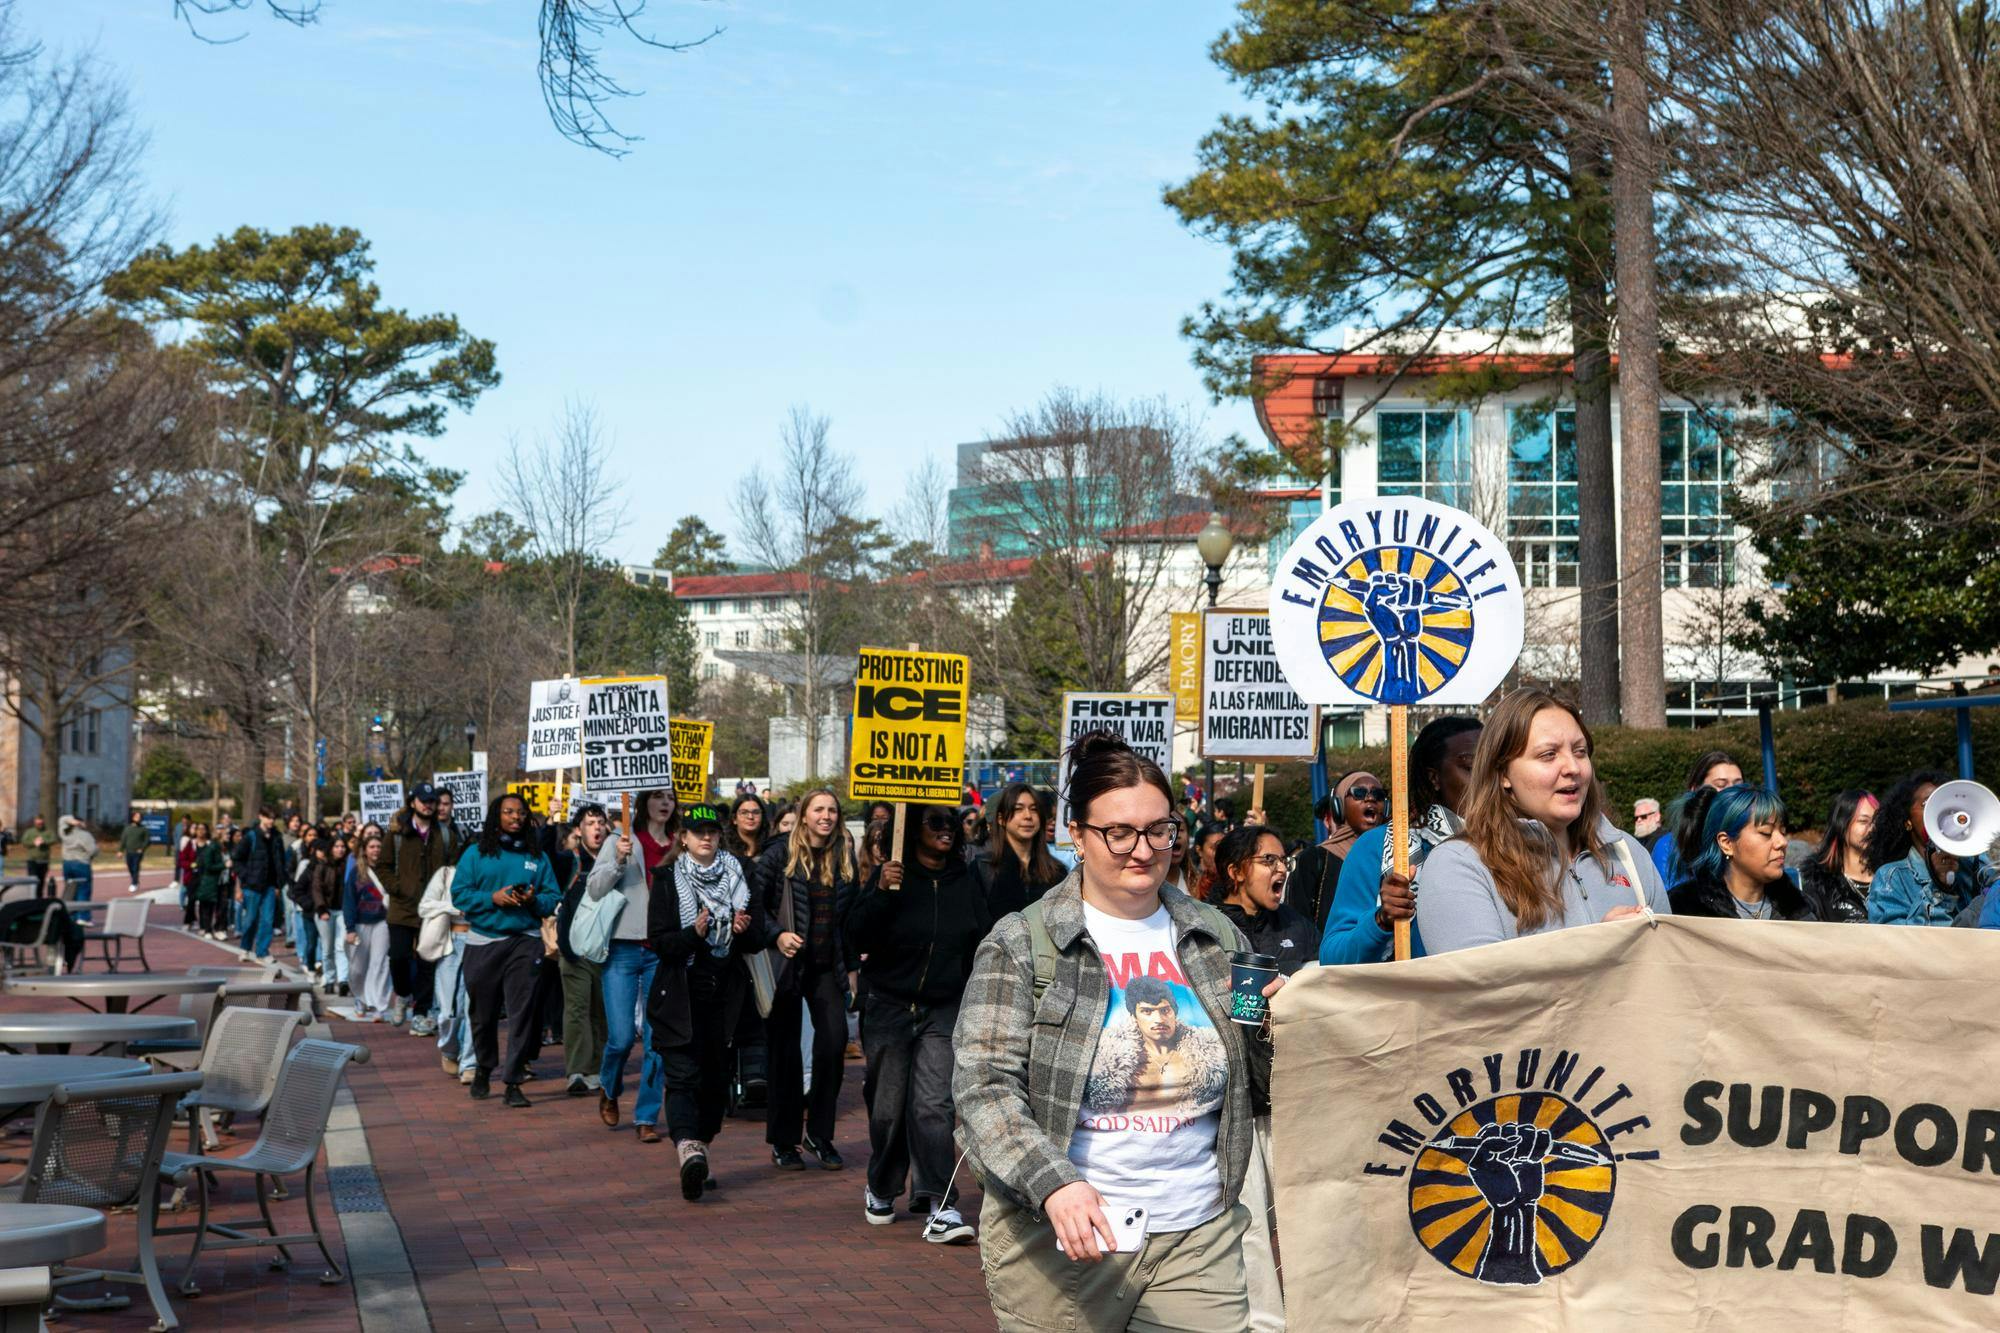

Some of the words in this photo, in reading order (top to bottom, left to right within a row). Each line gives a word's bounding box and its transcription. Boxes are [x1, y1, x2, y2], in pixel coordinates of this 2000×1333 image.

[1227, 618, 1245, 639] ¡EL
[1249, 618, 1272, 636] PUE
[1180, 619, 1196, 689] EMORY
[858, 654, 963, 685] PROTESTING
[1214, 660, 1288, 684] DEFENDE
[588, 690, 660, 716] ATLANTA
[858, 685, 961, 723] ICE
[1072, 700, 1169, 717] FIGHT
[1209, 691, 1218, 710] A
[1221, 691, 1245, 710] LAS
[532, 705, 574, 722] JUSTICE
[531, 728, 556, 744] ALEX
[557, 727, 581, 743] PRE
[583, 715, 666, 737] MINNEAPOLIS
[1131, 720, 1167, 745] WAR,
[1208, 716, 1309, 740] MIGRANTES!
[585, 737, 668, 755] STOP
[670, 729, 705, 747] NATHAN
[870, 730, 889, 759] IS
[892, 732, 932, 761] NOT
[934, 734, 947, 762] A
[532, 744, 560, 758] KILLED
[561, 743, 572, 755] BY
[671, 744, 681, 758] SS
[682, 747, 700, 760] FOR
[586, 757, 609, 779] ICE
[611, 754, 669, 777] TERROR
[672, 761, 700, 781] RDER
[854, 763, 961, 782] CRIME!
[465, 792, 480, 803] FOR
[854, 784, 873, 794] PARTY
[874, 785, 885, 794] FOR
[885, 786, 916, 797] SOCIALISM
[917, 787, 925, 797] &
[925, 788, 959, 799] LIBERATION
[1133, 1115, 1180, 1133] SAID
[1671, 1204, 1898, 1278] GRAD
